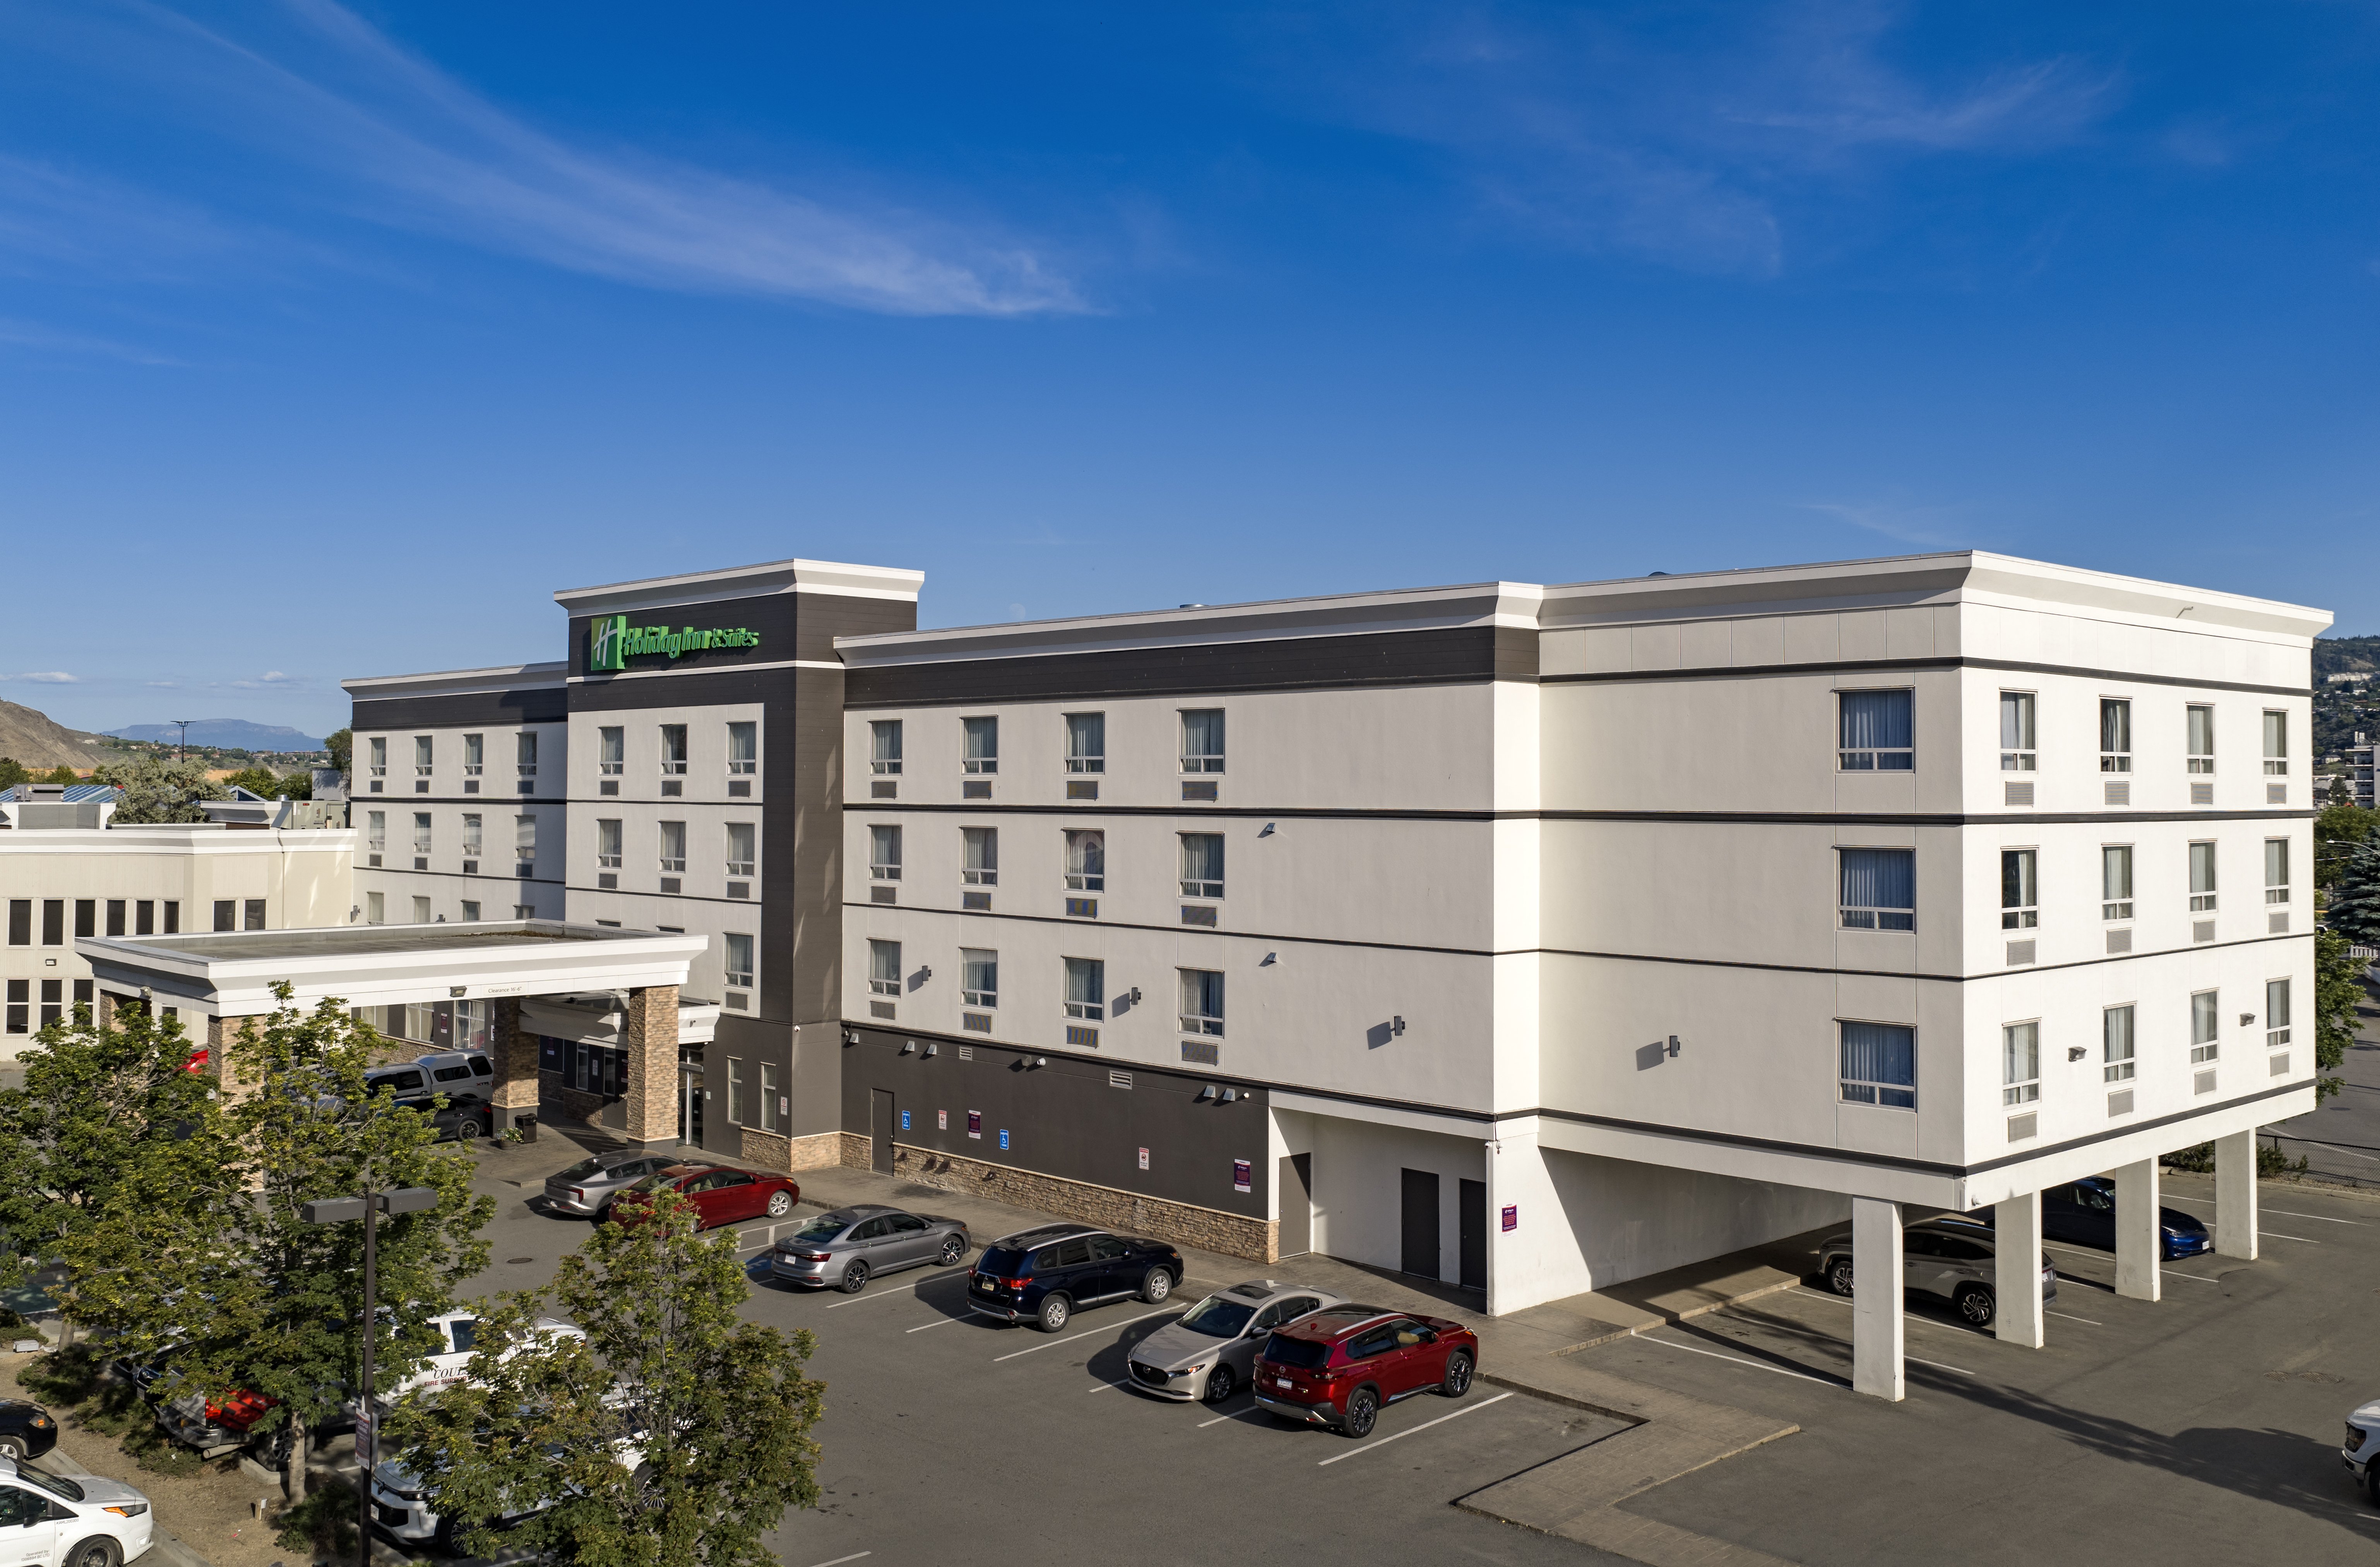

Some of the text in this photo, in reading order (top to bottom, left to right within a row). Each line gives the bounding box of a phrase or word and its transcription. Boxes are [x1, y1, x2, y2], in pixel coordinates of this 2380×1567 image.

[623, 626, 759, 659] Holiday Inn & Suites
